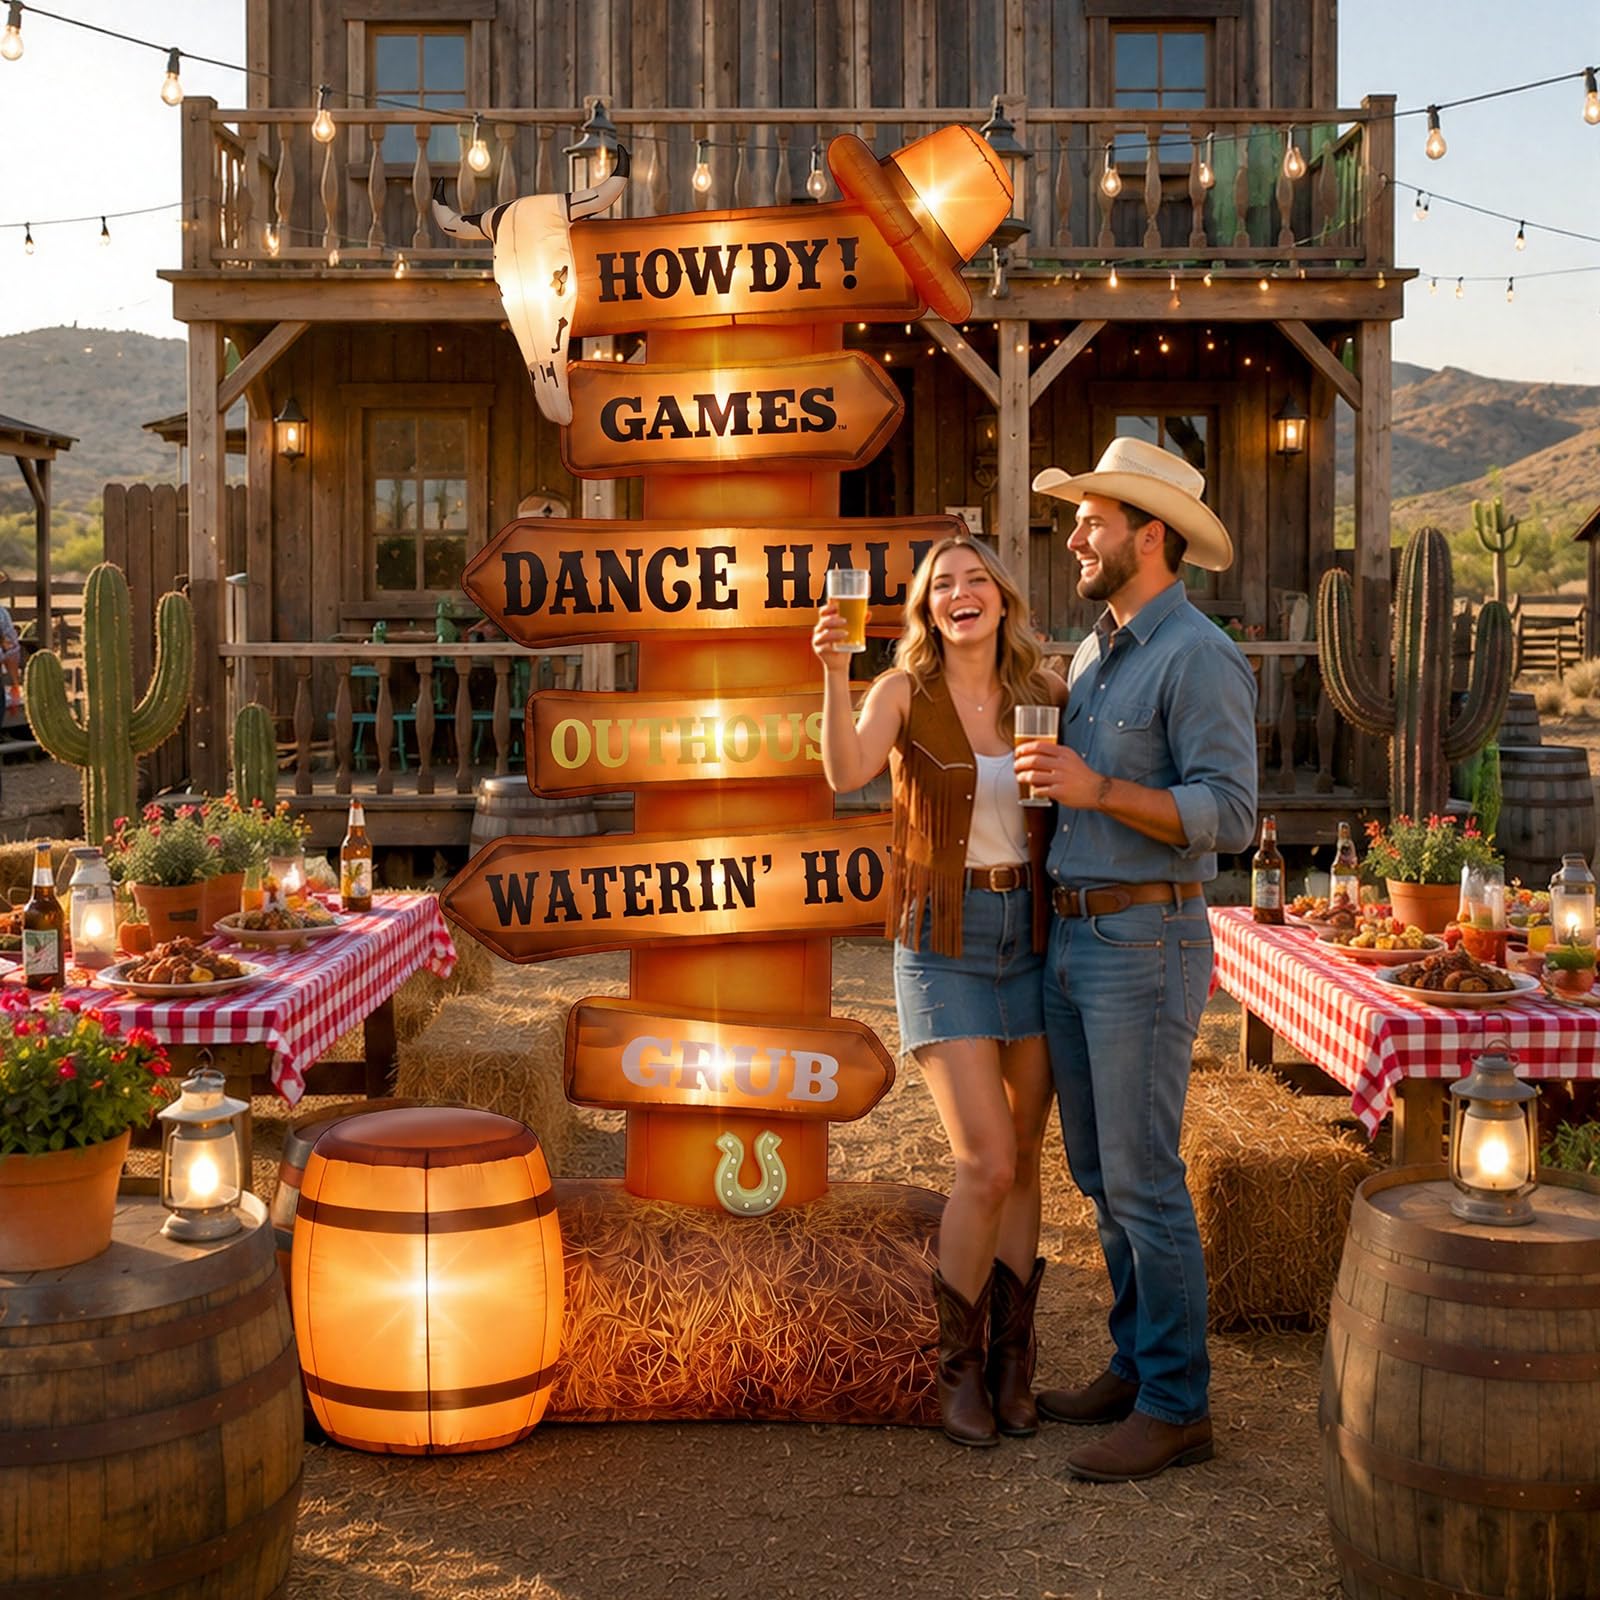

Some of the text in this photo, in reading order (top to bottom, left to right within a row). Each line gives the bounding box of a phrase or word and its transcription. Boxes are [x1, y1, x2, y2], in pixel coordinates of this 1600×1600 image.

[596, 237, 859, 302] HOWDY!
[600, 387, 837, 442] GAMES
[501, 545, 739, 617] DANCE
[550, 712, 861, 769] OUTHOUS
[621, 1035, 839, 1102] GRUB
